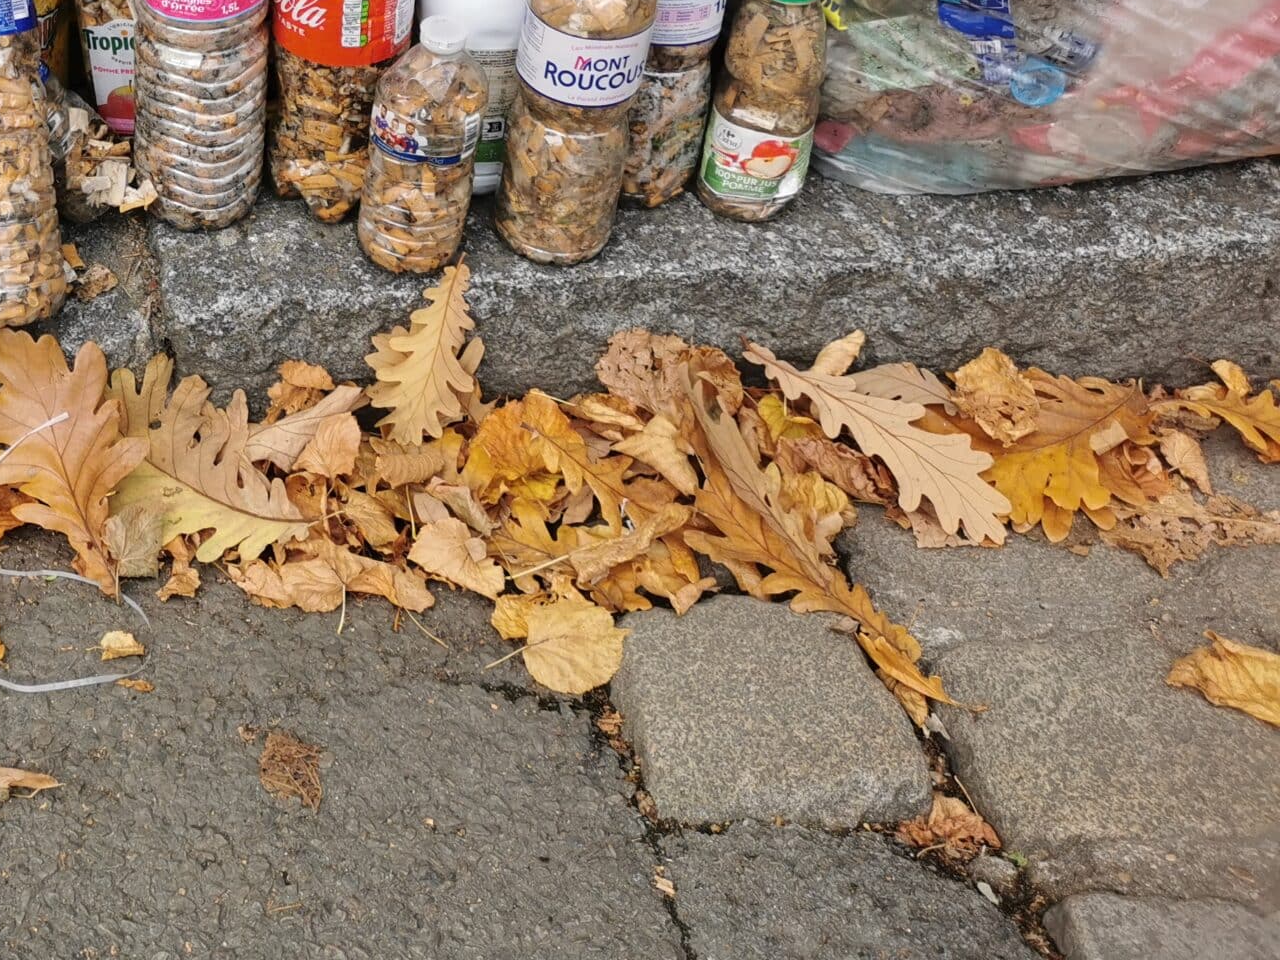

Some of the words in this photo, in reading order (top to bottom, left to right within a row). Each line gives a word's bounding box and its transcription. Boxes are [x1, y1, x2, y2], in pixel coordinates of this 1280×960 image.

[573, 54, 631, 73] MONT
[543, 59, 645, 92] ROUCOUS
[736, 175, 758, 186] PUR
